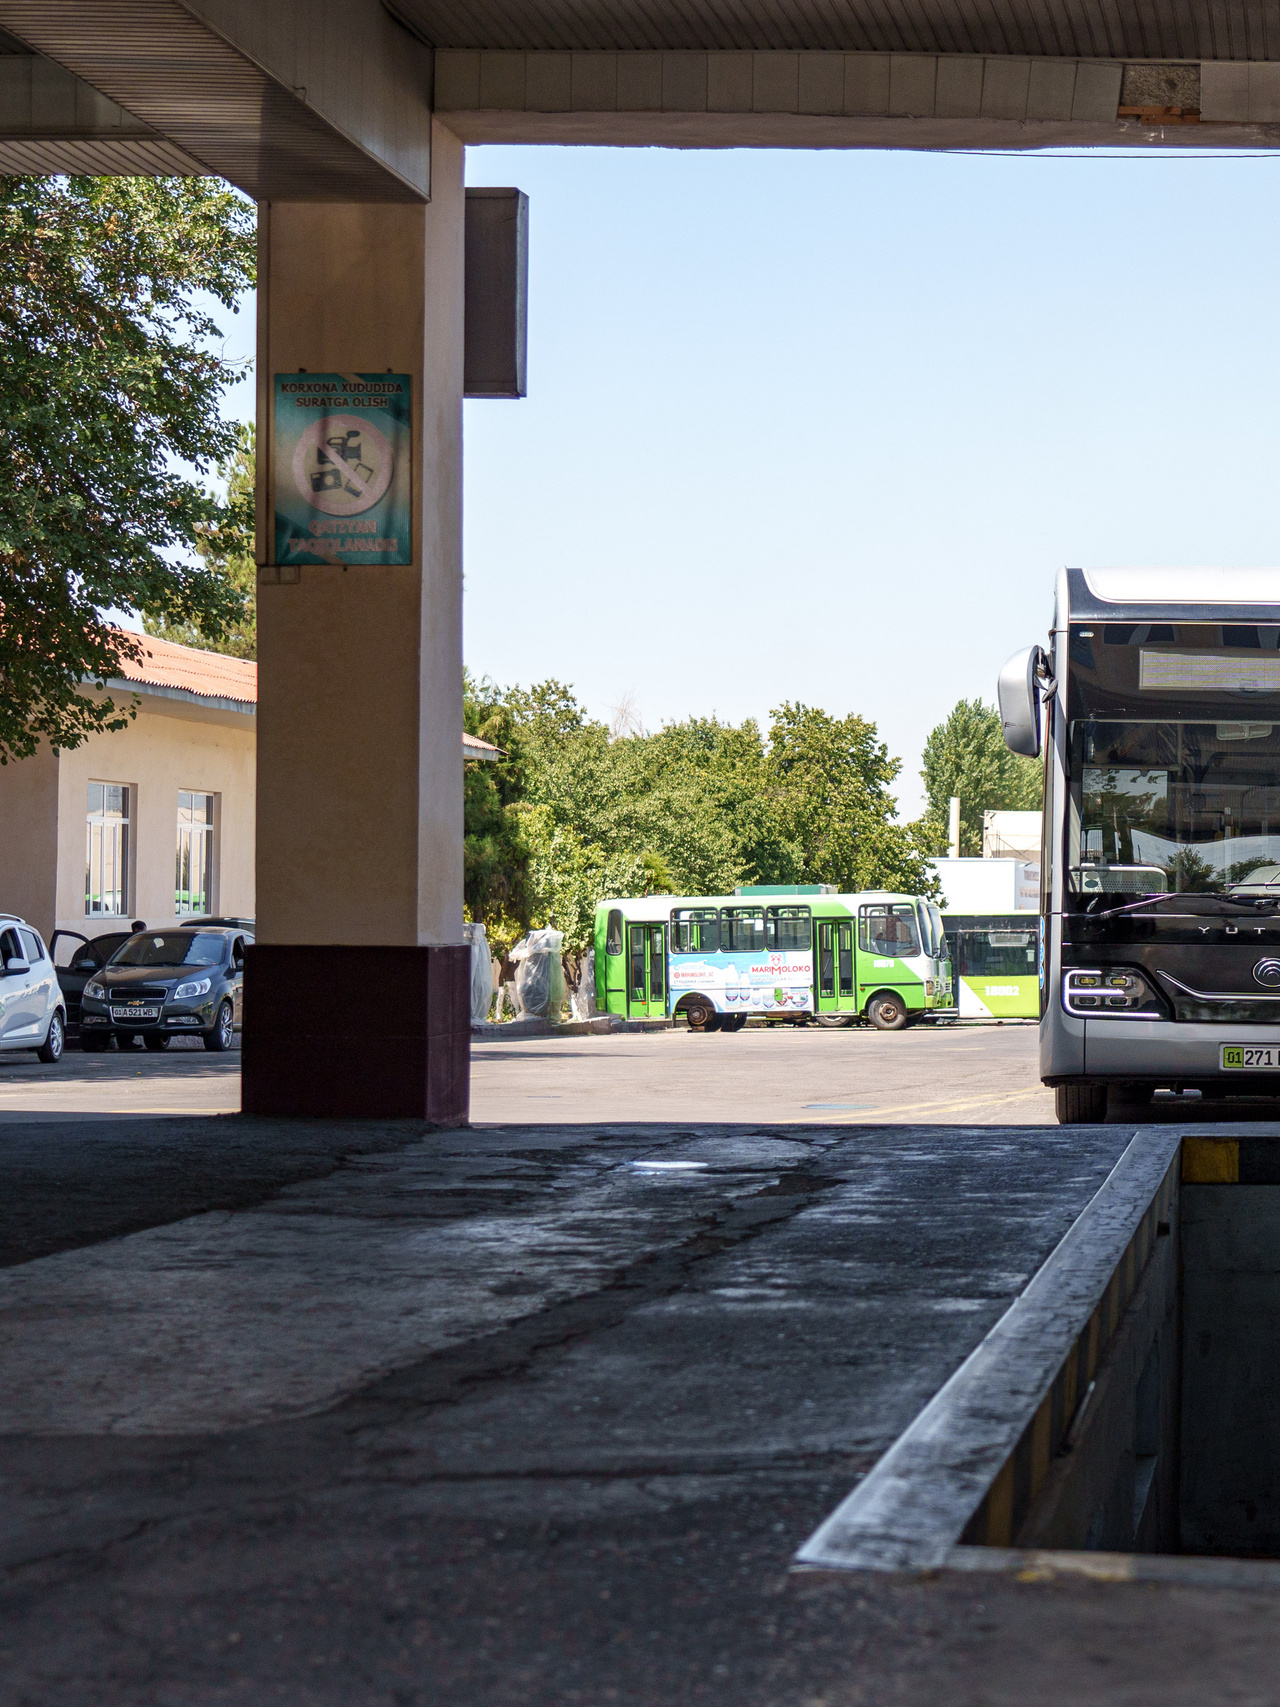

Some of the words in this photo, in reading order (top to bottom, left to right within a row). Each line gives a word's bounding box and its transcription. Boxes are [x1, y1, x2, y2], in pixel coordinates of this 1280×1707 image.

[281, 383, 338, 393] KORXONA
[341, 383, 403, 393] XUDUDIDA
[296, 397, 349, 407] SURATGA
[353, 397, 388, 407] OLISH
[751, 965, 811, 975] MARIMOLOKO
[1227, 1052, 1242, 1063] 01
[1245, 1050, 1273, 1066] 271
